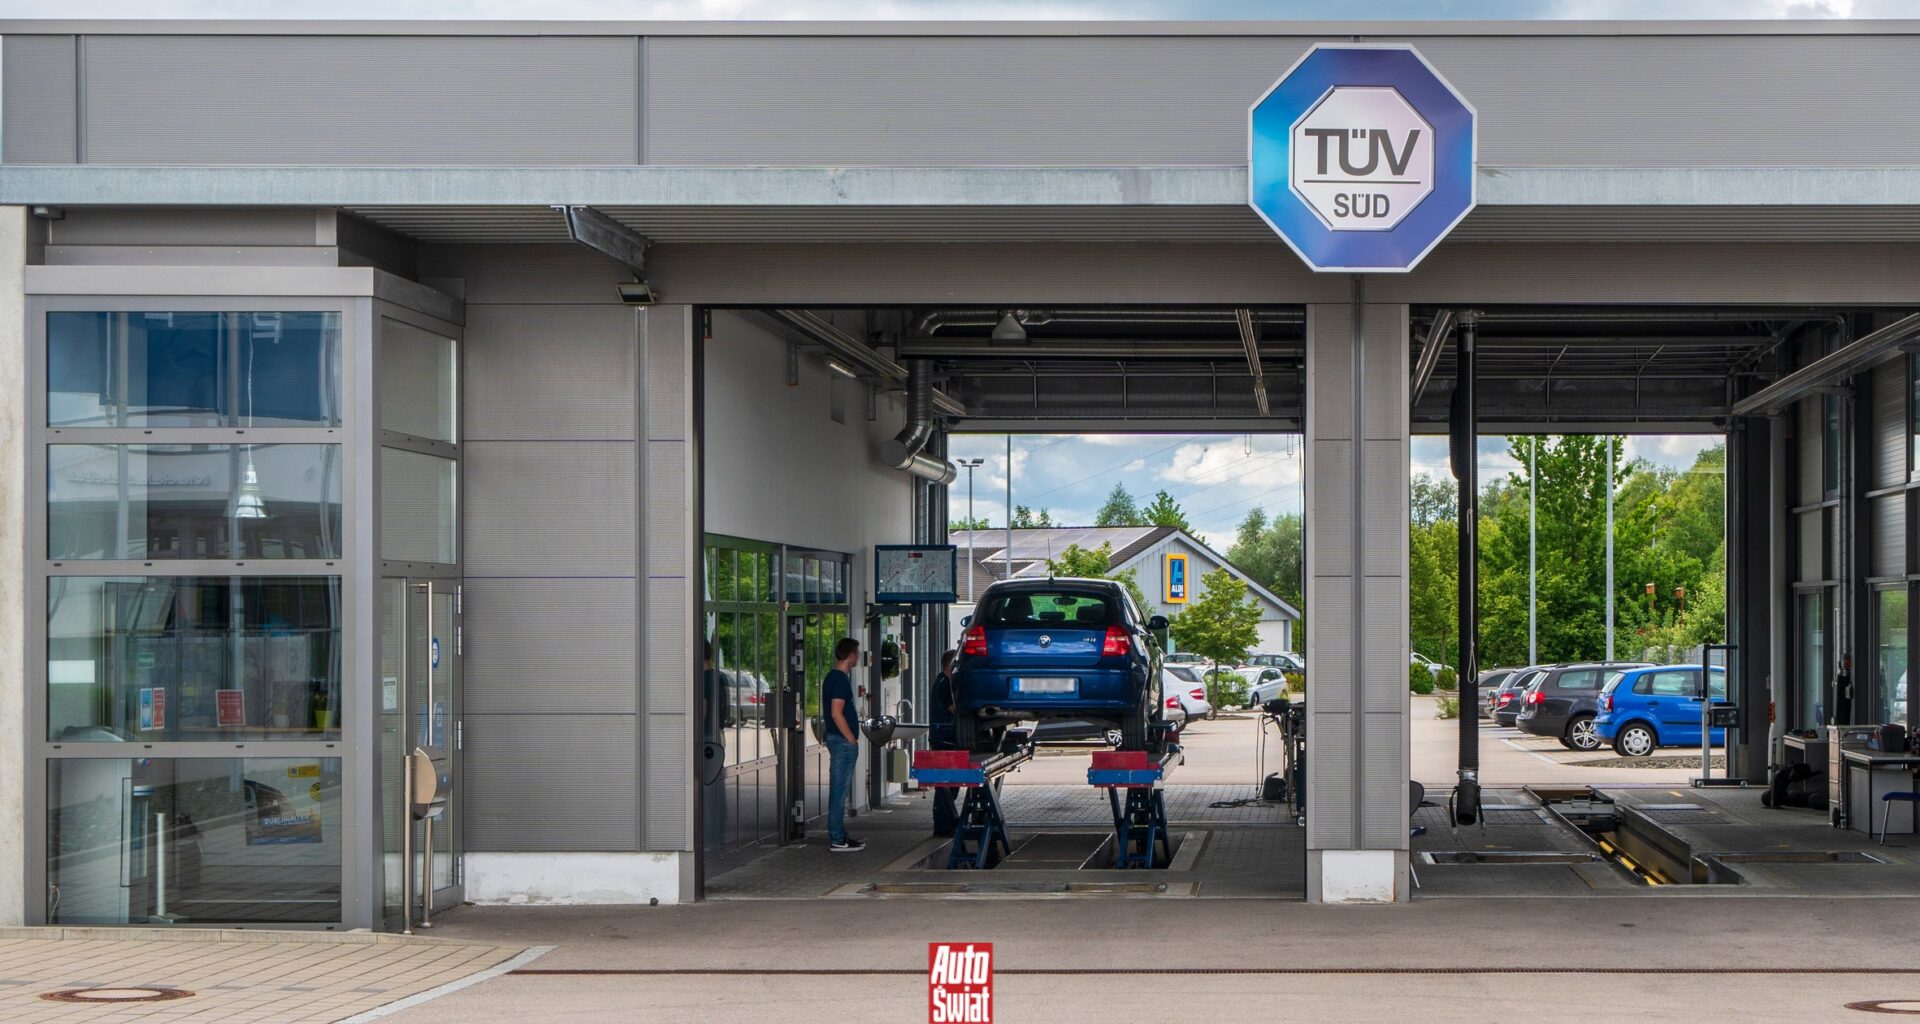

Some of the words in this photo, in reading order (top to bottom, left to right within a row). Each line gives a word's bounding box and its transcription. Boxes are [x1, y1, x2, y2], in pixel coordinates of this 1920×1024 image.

[1304, 128, 1421, 176] TÜV
[1333, 193, 1390, 218] SÜD
[1171, 584, 1184, 593] ALDI
